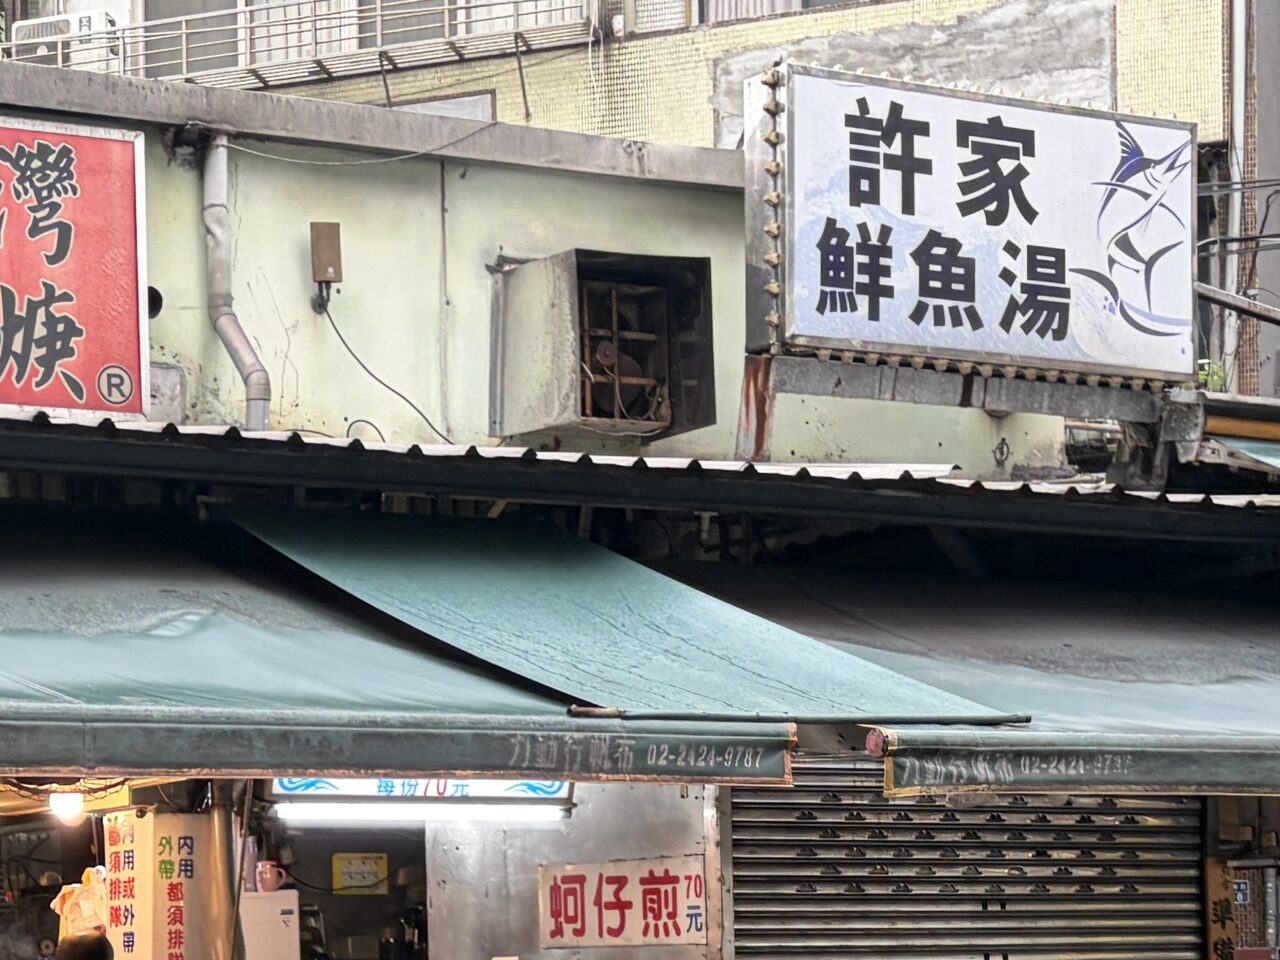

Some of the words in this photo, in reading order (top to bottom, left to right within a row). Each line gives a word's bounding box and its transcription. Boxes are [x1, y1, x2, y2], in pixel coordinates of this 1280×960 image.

[845, 97, 1038, 226] 許家
[816, 217, 1071, 342] 鮮魚湯
[647, 743, 764, 769] 02-2424-9787
[549, 869, 681, 939] 蚵仔煎
